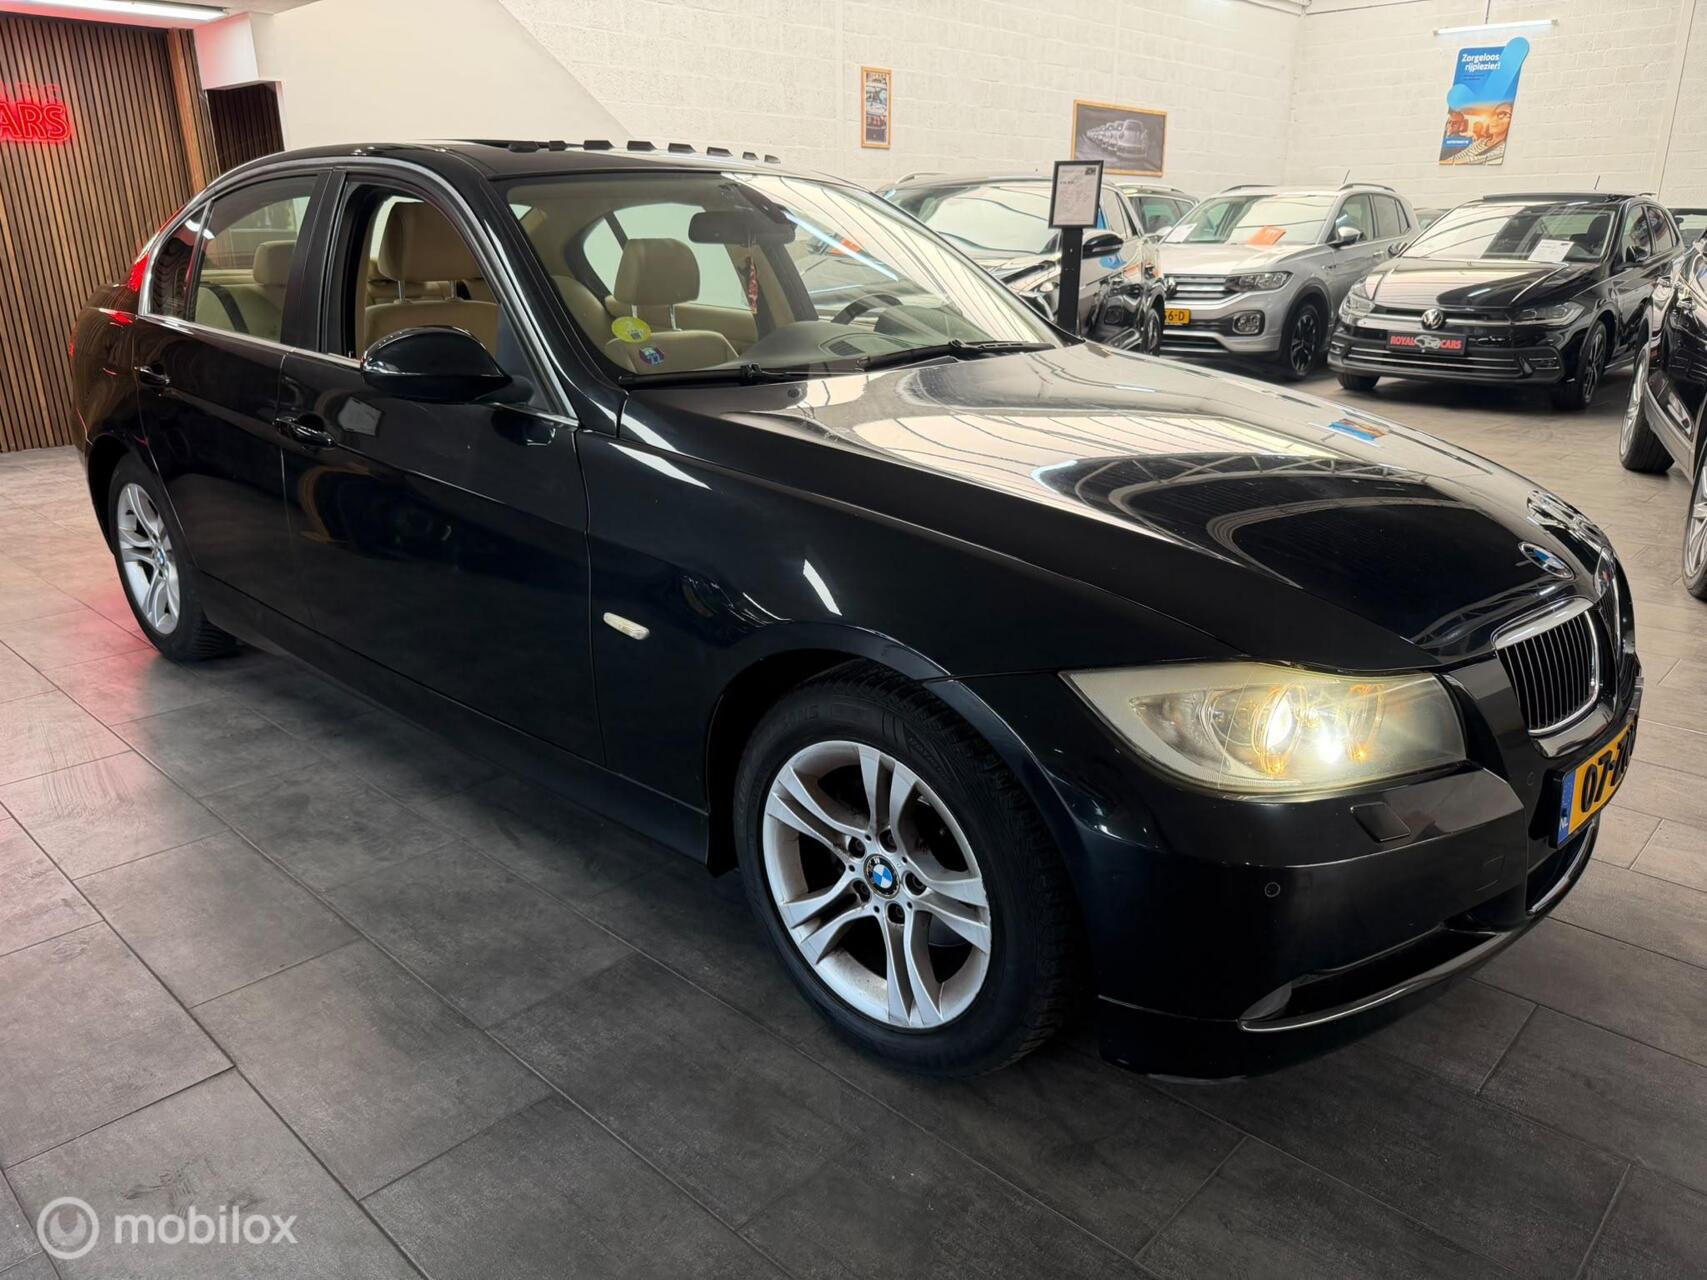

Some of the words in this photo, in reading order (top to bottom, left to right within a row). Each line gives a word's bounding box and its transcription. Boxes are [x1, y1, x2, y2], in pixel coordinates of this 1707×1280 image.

[1461, 52, 1500, 63] Zorgeloos
[1390, 335, 1416, 346] ROYAL
[1440, 339, 1462, 349] CARS
[1559, 816, 1568, 831] NL
